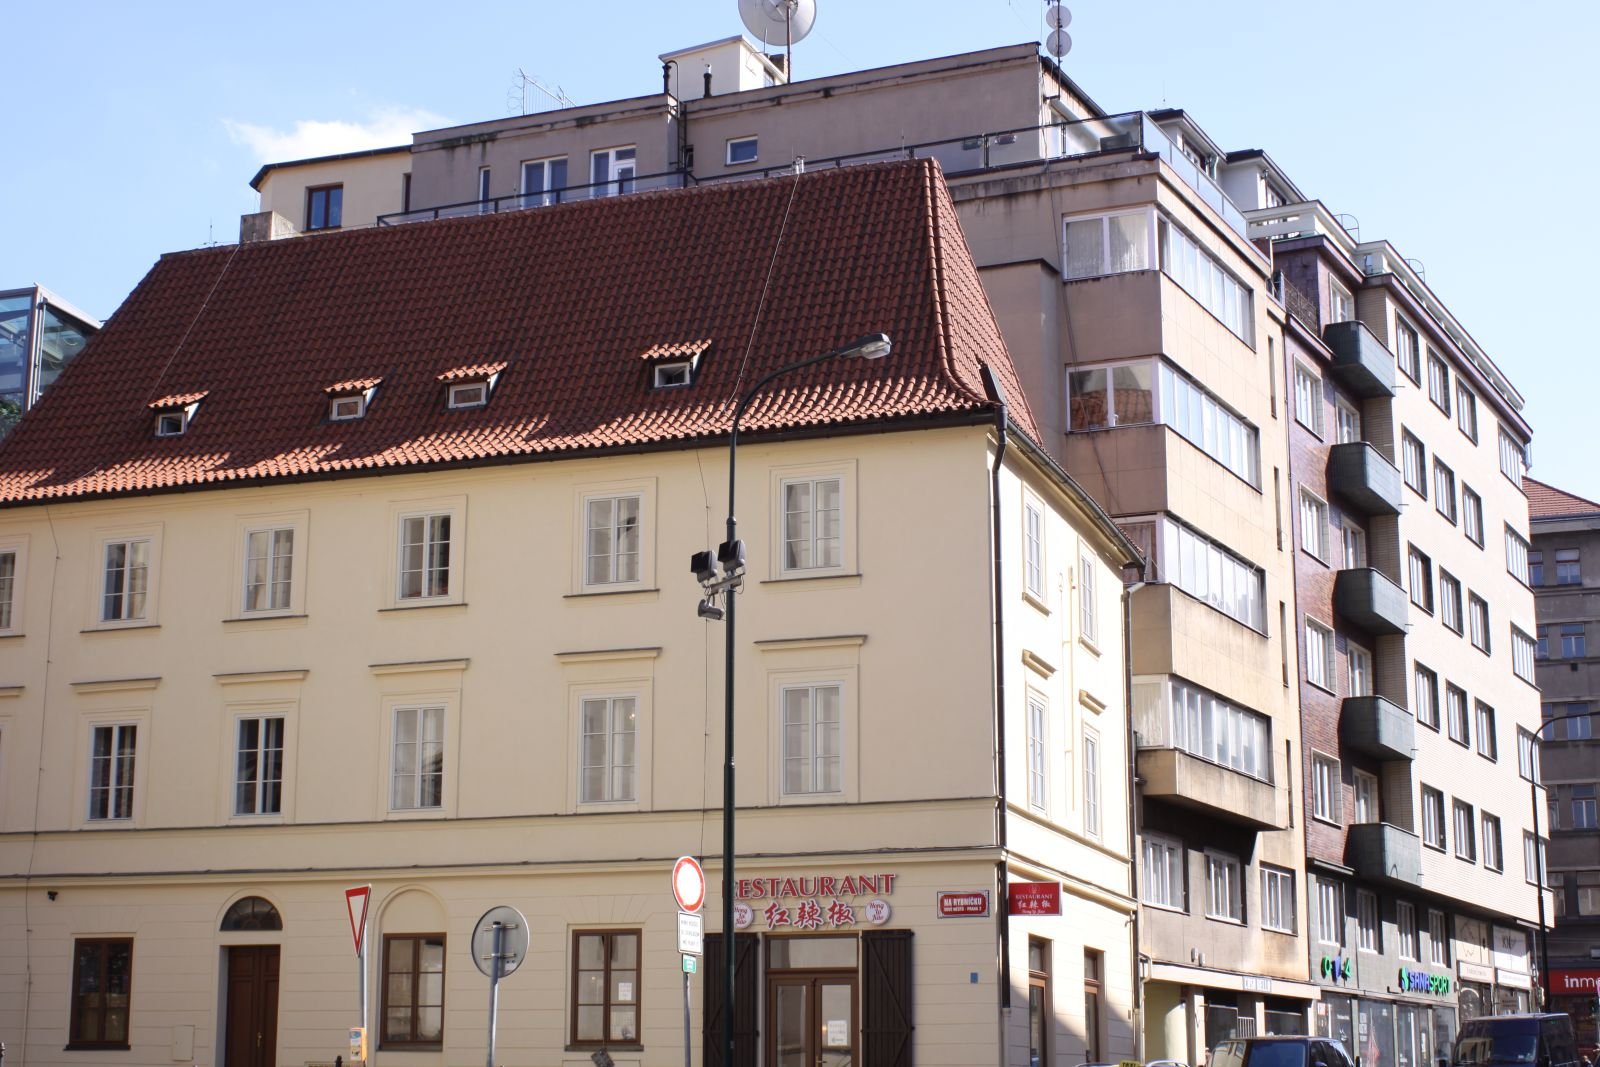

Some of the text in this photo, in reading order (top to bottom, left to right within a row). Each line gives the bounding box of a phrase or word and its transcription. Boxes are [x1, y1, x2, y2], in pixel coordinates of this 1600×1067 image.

[722, 873, 896, 898] ESTAURANT
[944, 898, 952, 906] NA
[764, 899, 856, 929] 红辣椒
[1409, 972, 1451, 993] SANASPORT
